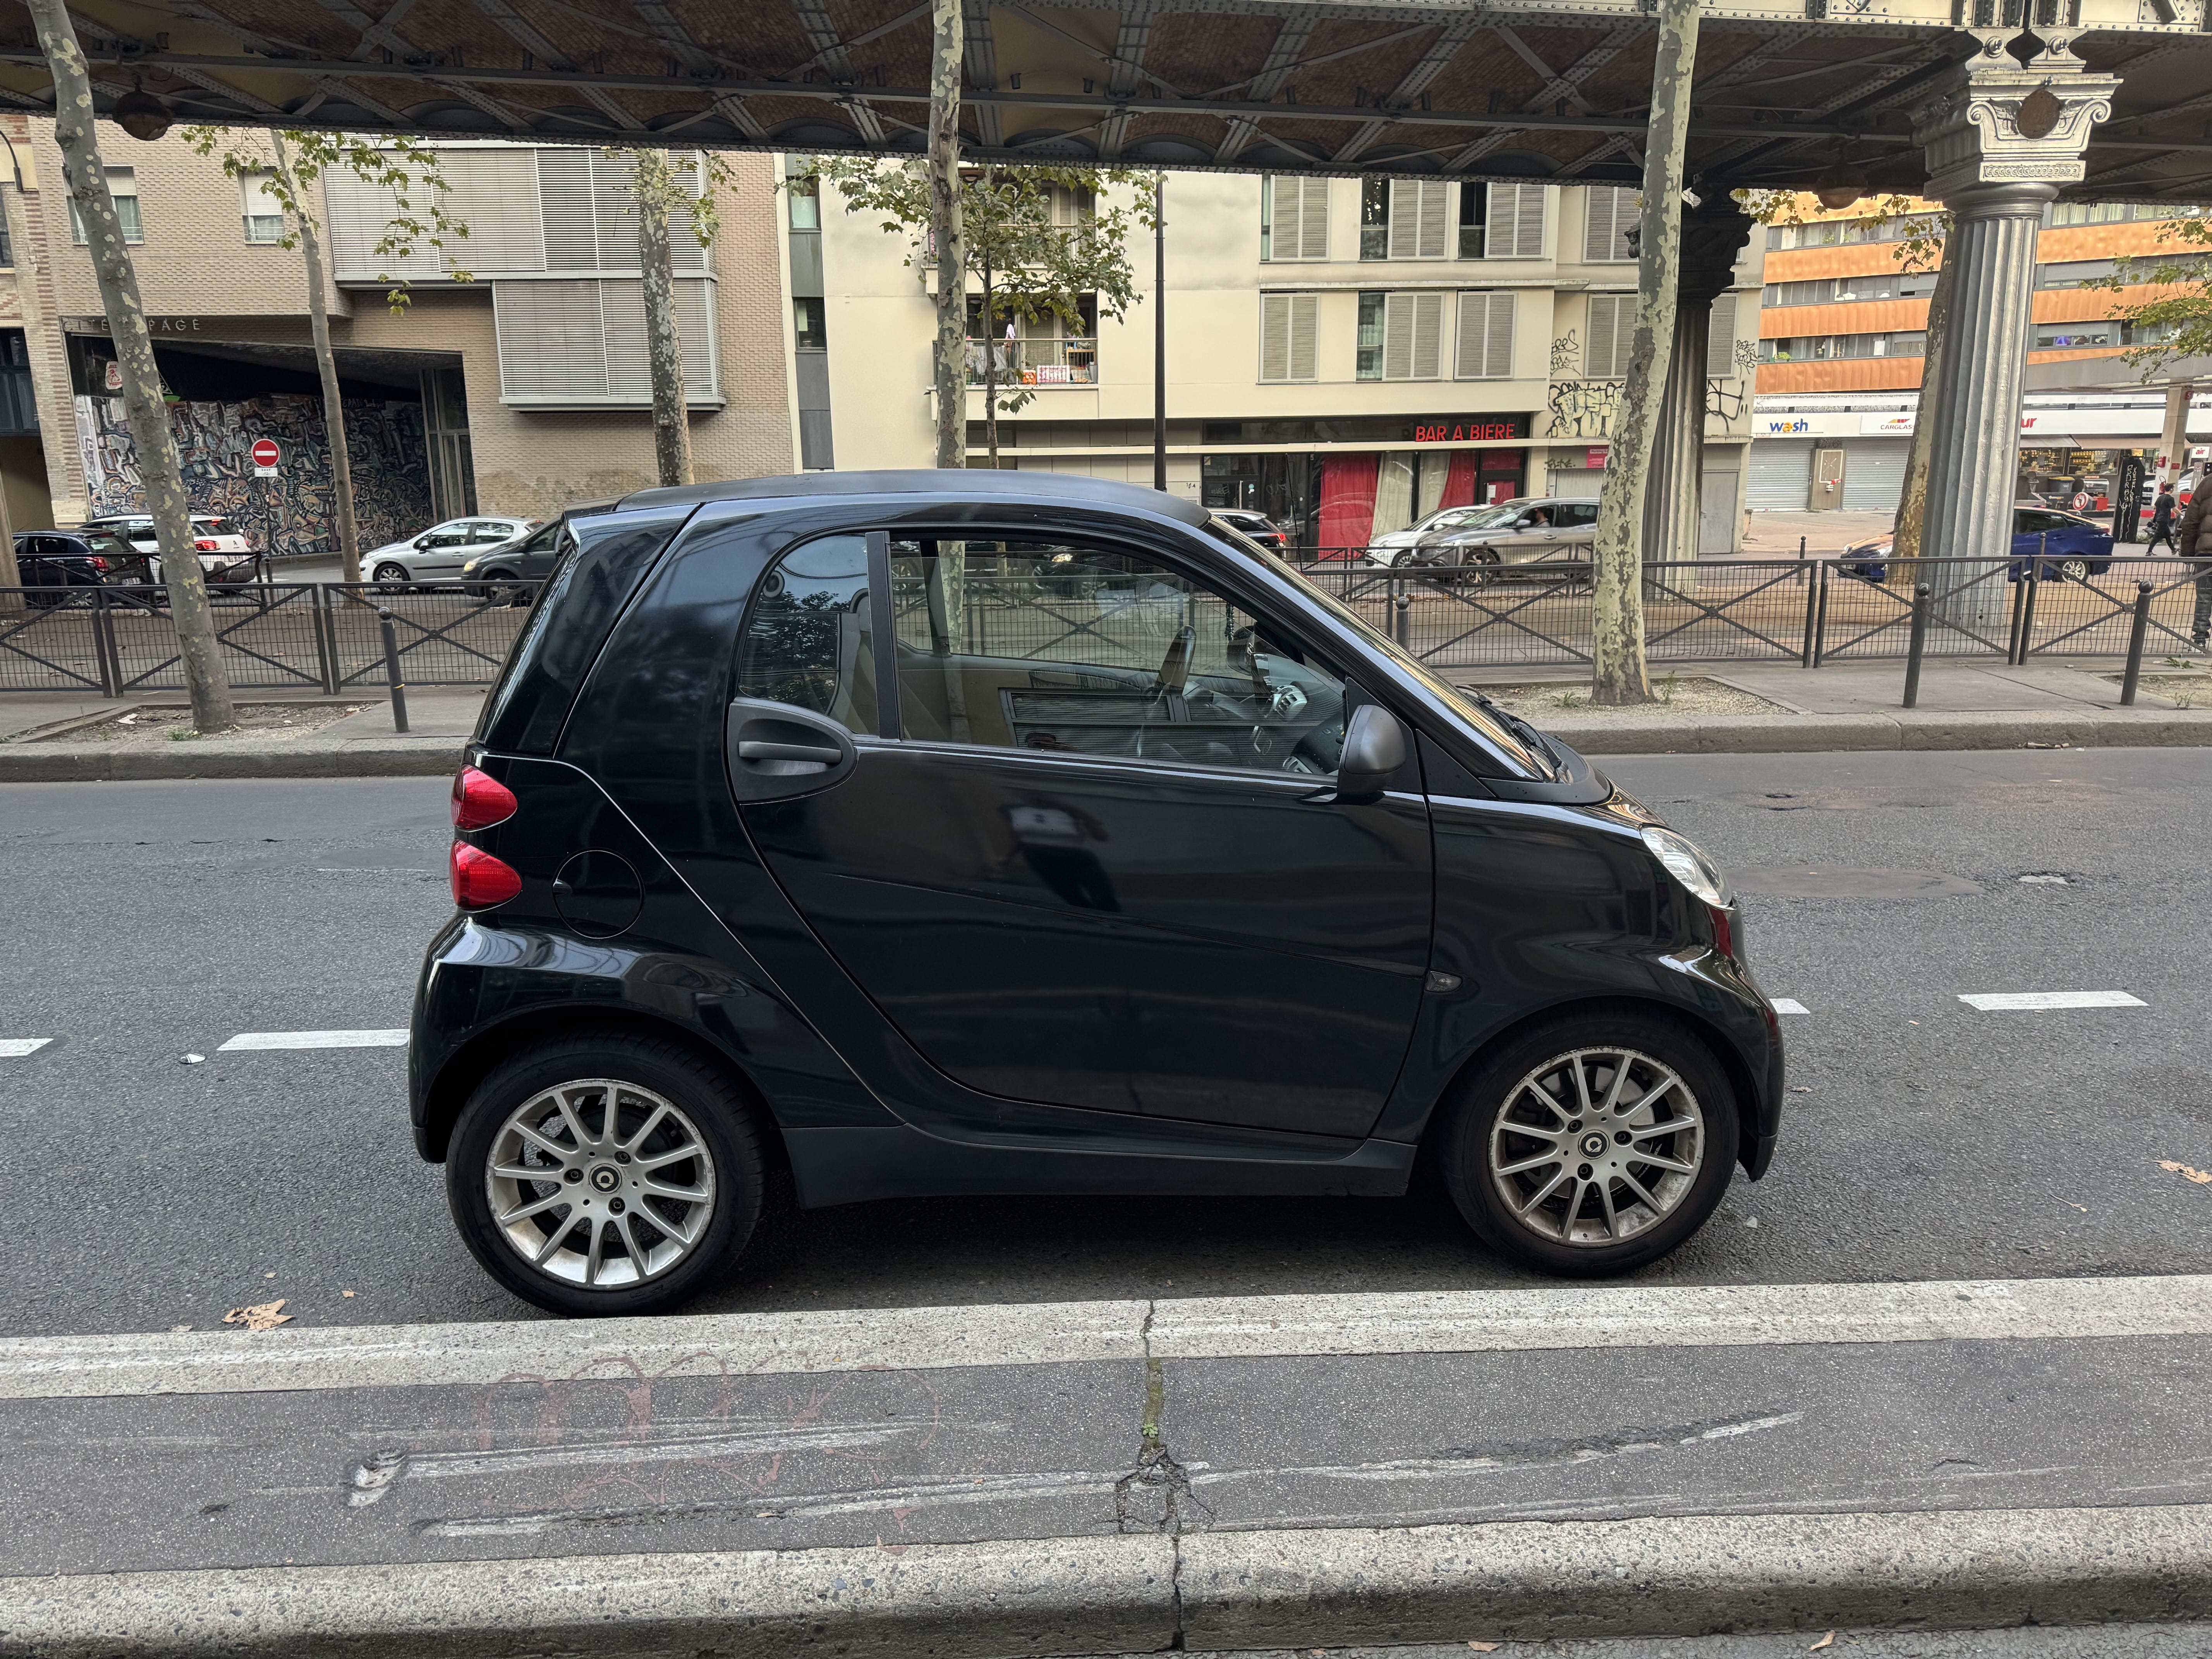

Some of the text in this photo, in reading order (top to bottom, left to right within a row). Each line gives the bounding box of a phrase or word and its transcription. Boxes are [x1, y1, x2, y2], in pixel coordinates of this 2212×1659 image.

[148, 319, 200, 331] PAGE
[1769, 418, 1808, 433] wash
[2021, 418, 2037, 428] ur
[1415, 424, 1515, 442] BAR A BIERE
